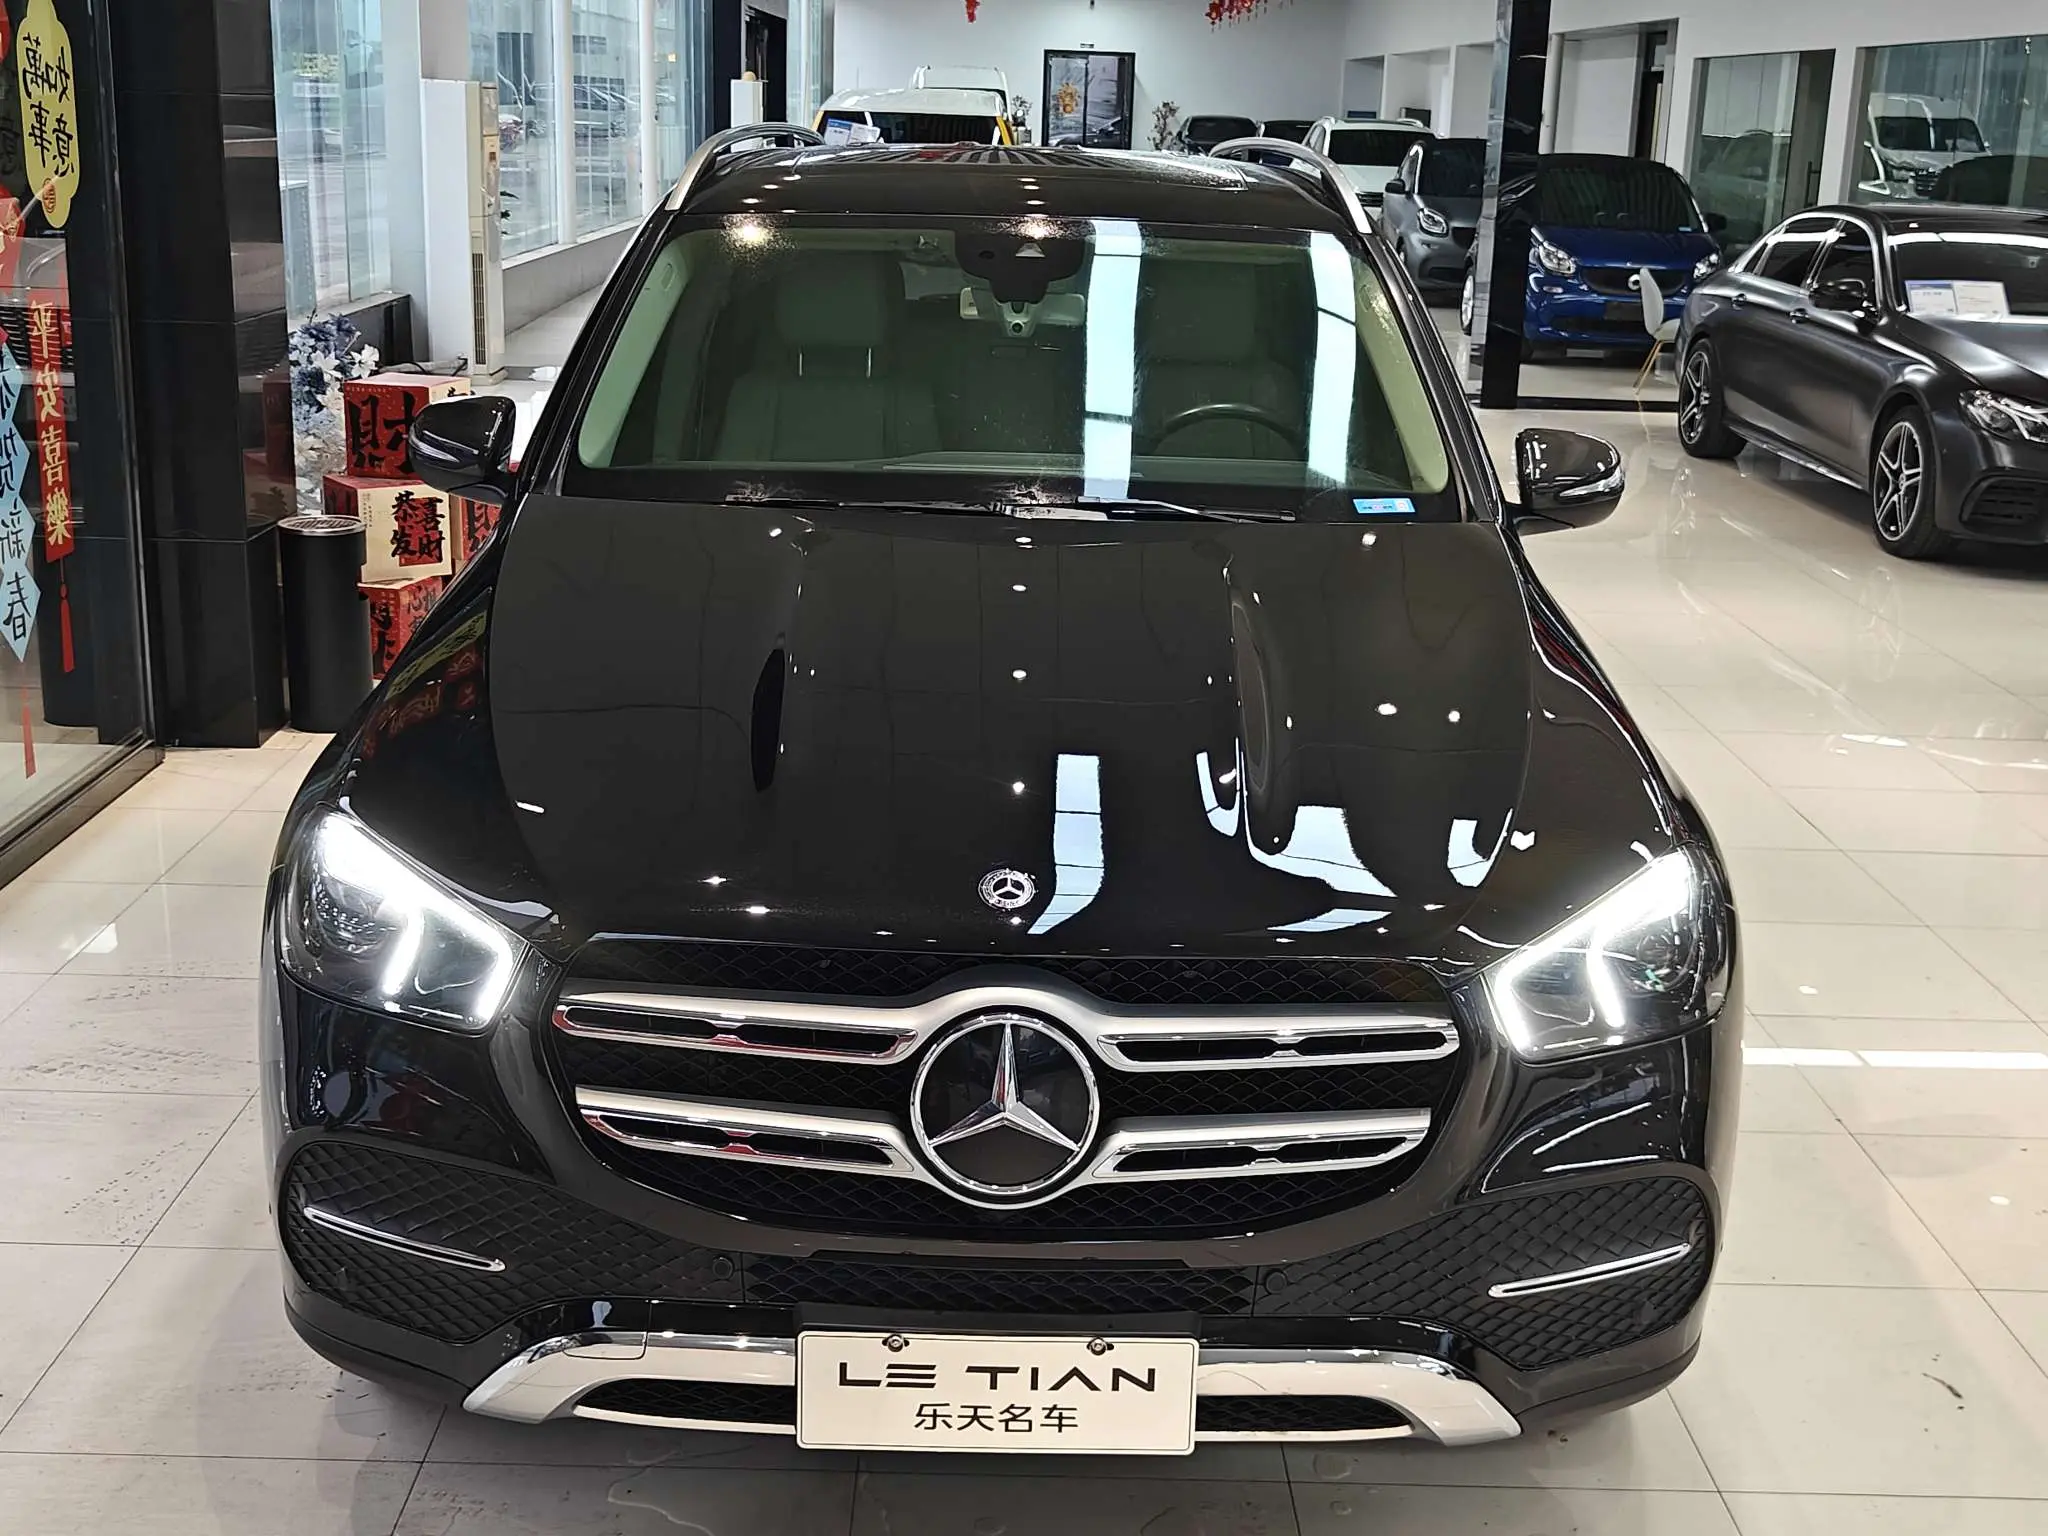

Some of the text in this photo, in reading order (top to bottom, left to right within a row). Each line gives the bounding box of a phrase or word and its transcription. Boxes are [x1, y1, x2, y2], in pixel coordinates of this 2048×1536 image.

[839, 1362, 1156, 1392] LE TIAN
[914, 1402, 1079, 1433] 乐天名车
